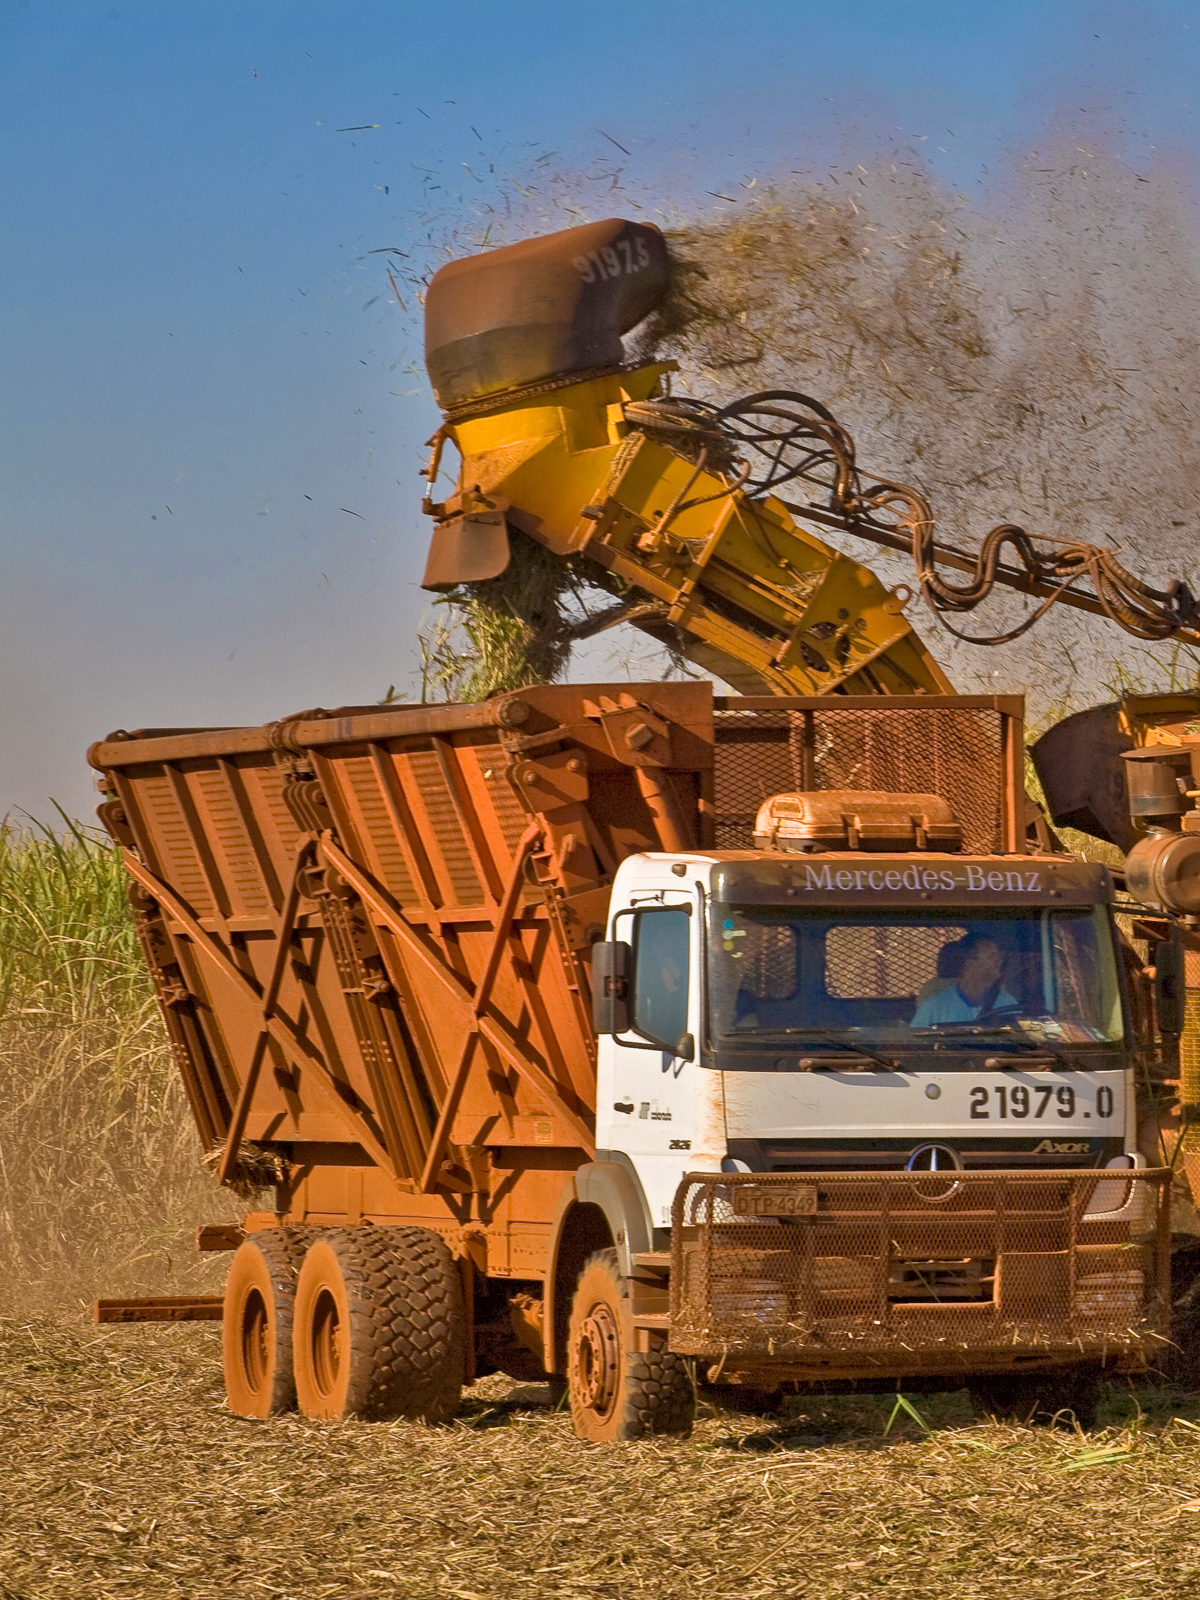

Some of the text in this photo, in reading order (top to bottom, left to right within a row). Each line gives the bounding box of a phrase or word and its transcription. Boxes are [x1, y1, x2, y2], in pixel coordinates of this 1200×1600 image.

[573, 236, 650, 283] 9197.5
[802, 864, 1042, 892] Mercedes-Benz
[969, 1085, 1114, 1119] 21979.0
